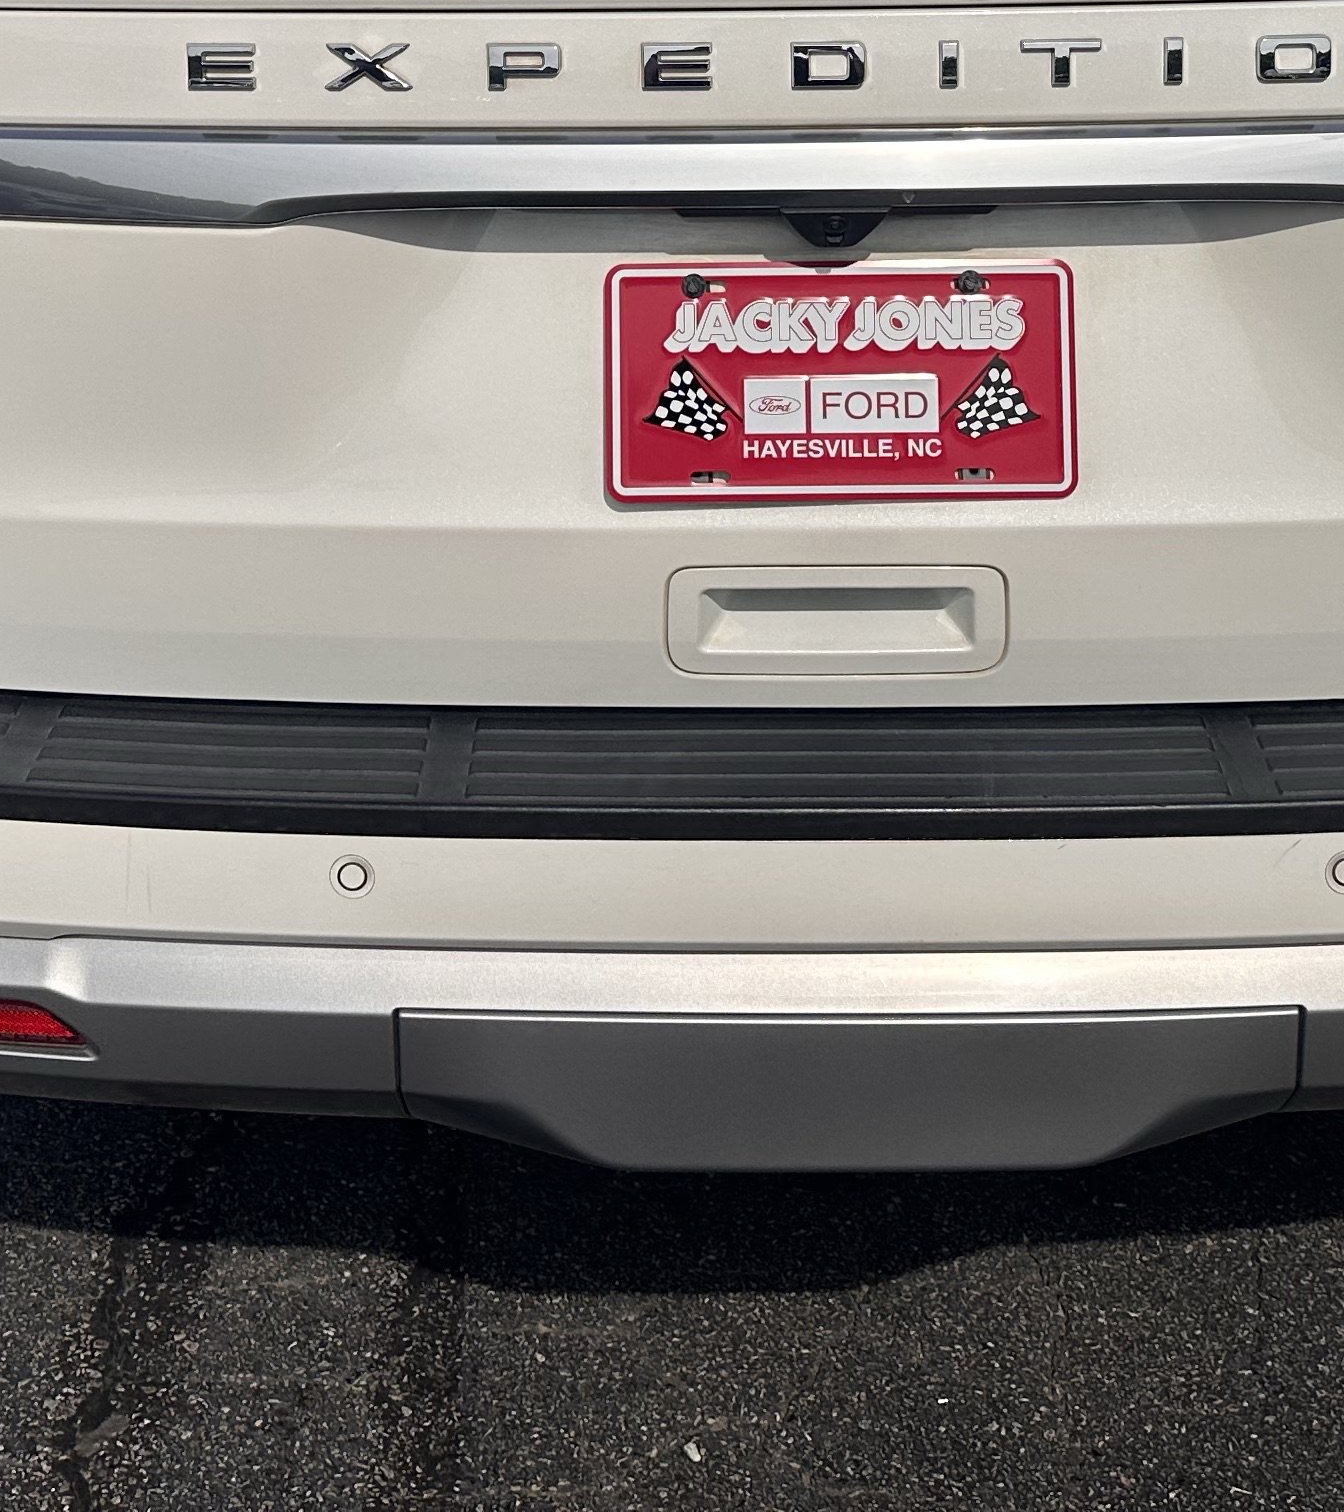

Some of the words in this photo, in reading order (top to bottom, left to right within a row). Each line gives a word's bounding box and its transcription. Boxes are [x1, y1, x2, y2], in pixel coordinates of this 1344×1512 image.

[663, 296, 851, 353] JACKY
[844, 295, 1026, 351] JONES
[758, 397, 792, 413] Ford
[821, 391, 929, 420] FORD
[743, 439, 900, 461] HAYESVILLE,
[908, 438, 943, 458] NC
